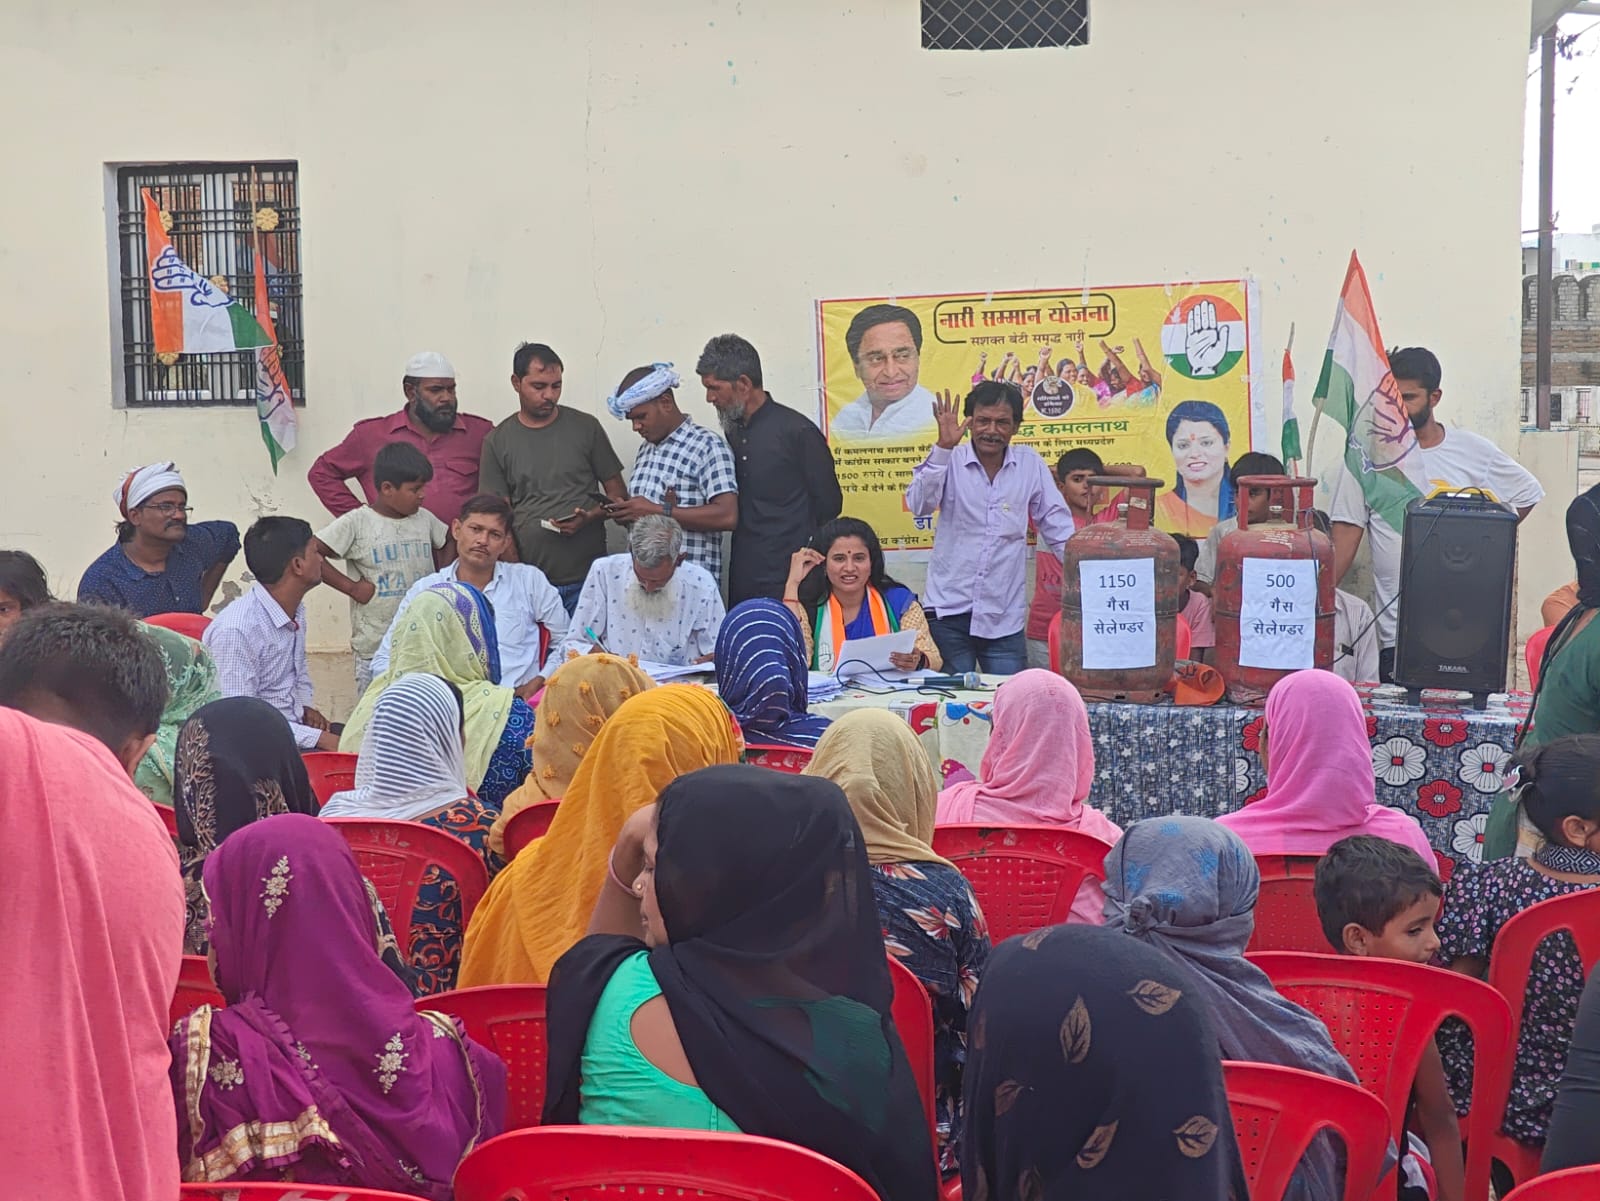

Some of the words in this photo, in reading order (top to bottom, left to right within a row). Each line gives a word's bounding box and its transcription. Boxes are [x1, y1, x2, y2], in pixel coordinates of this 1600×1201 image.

[939, 306, 975, 328] नारी
[981, 308, 1042, 327] सम्मान
[1048, 301, 1109, 323] योजना
[970, 334, 1005, 345] सशक्त
[1008, 332, 1028, 344] बेटी
[1032, 332, 1062, 346] समृद्ध
[1064, 329, 1085, 342] नारी
[1040, 419, 1129, 435] कमलनाथ
[844, 447, 884, 455] कमलनाथ
[1098, 574, 1136, 588] 1150
[1266, 574, 1295, 588] 500
[1106, 597, 1130, 612] गैस
[1269, 597, 1293, 613] गैस
[1093, 619, 1144, 635] सेलेण्डर
[1253, 620, 1304, 636] सेलेण्डर
